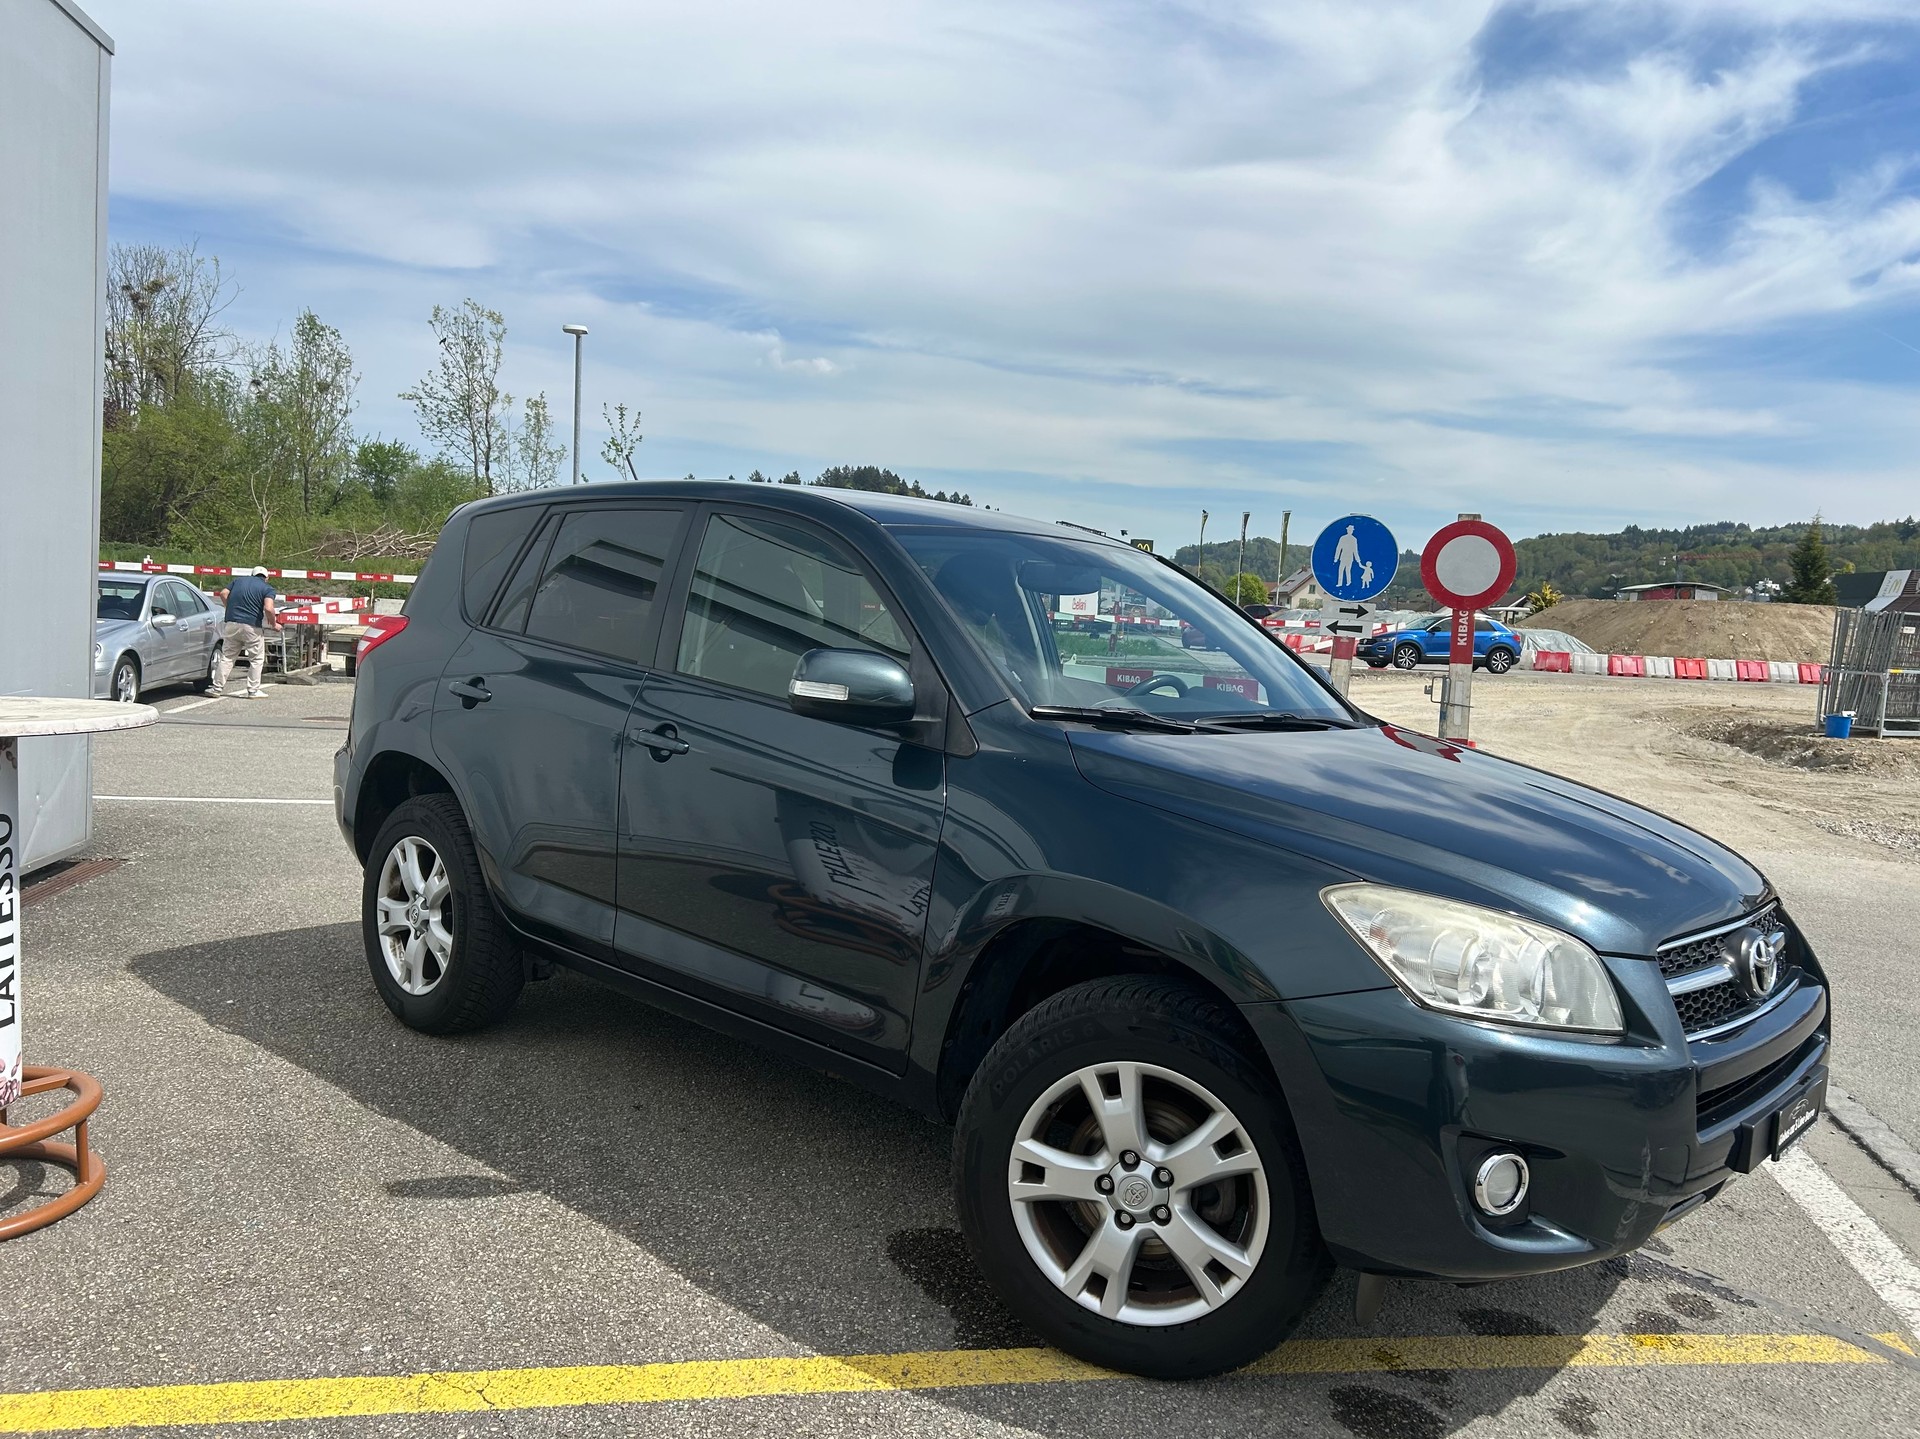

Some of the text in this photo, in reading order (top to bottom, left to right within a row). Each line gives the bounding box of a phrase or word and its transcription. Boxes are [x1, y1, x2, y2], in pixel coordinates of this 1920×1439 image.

[1457, 610, 1469, 646] KIBAG
[1117, 674, 1140, 684] KIBAG
[1216, 683, 1244, 693] KIBAG
[992, 1022, 1094, 1097] POLARIS 6
